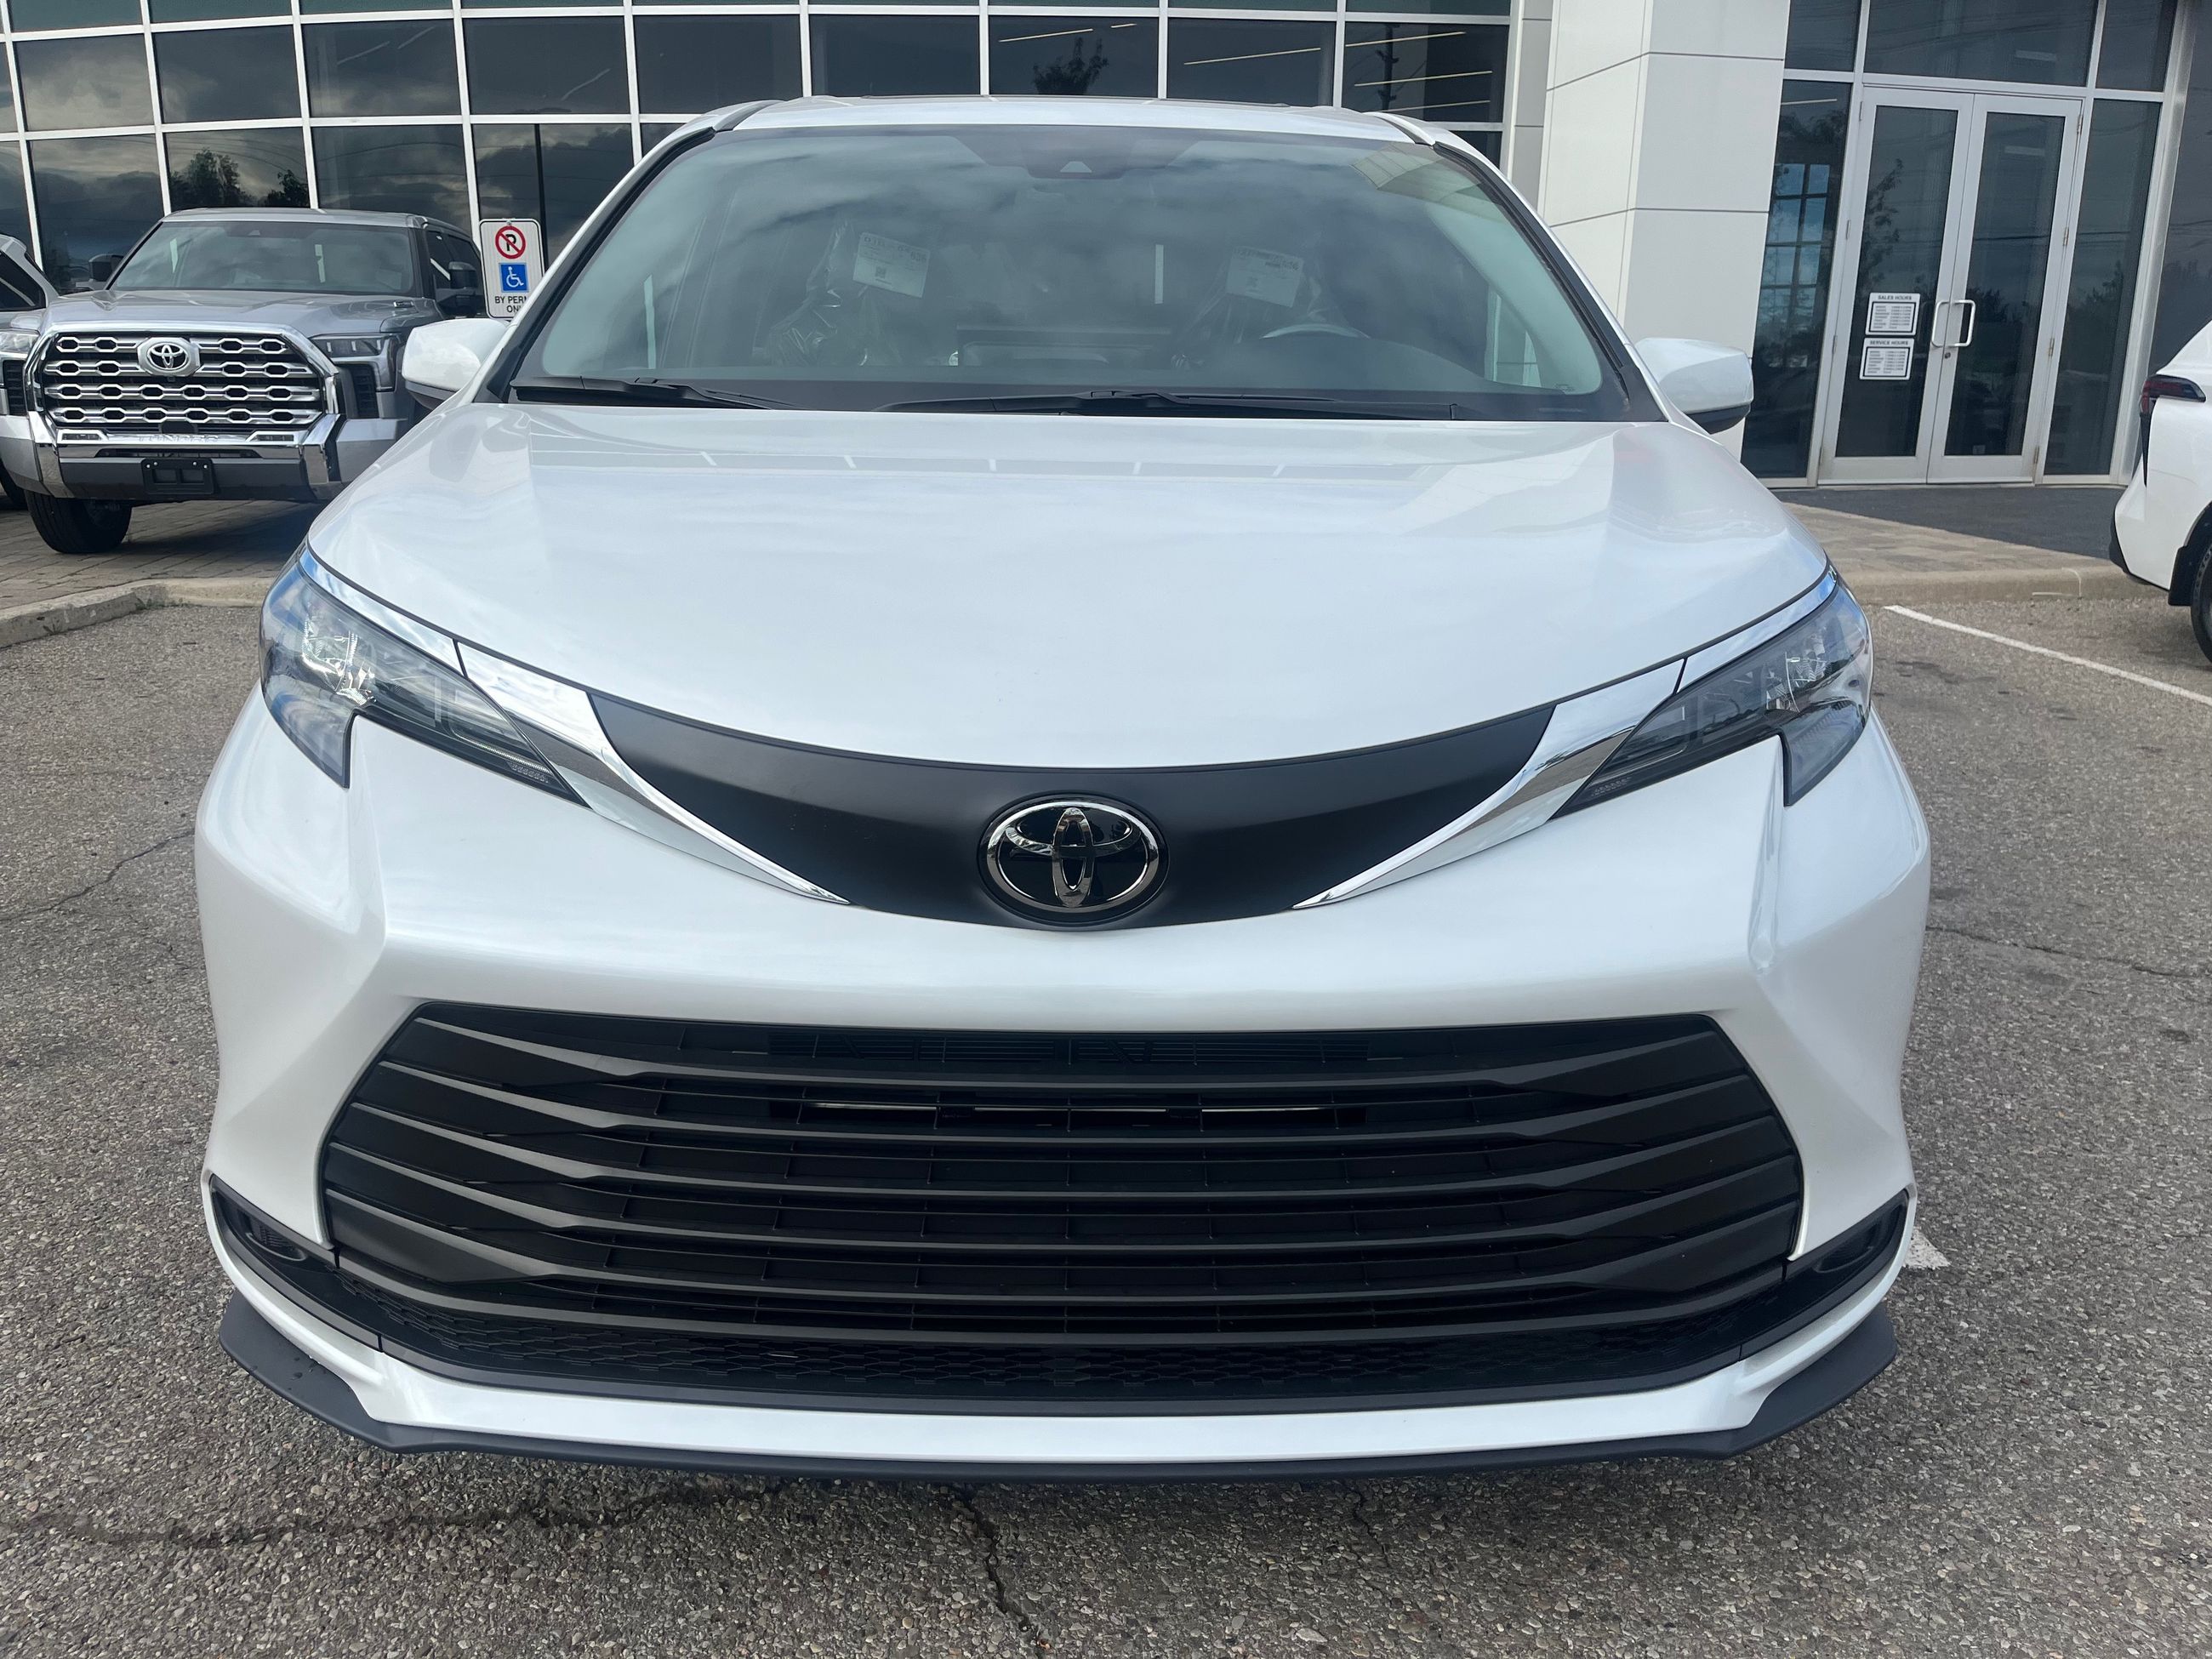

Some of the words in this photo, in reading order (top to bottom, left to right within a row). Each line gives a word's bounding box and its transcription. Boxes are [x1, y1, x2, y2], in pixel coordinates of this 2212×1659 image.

[494, 295, 505, 304] BY
[507, 295, 527, 304] PER
[506, 305, 522, 313] ON
